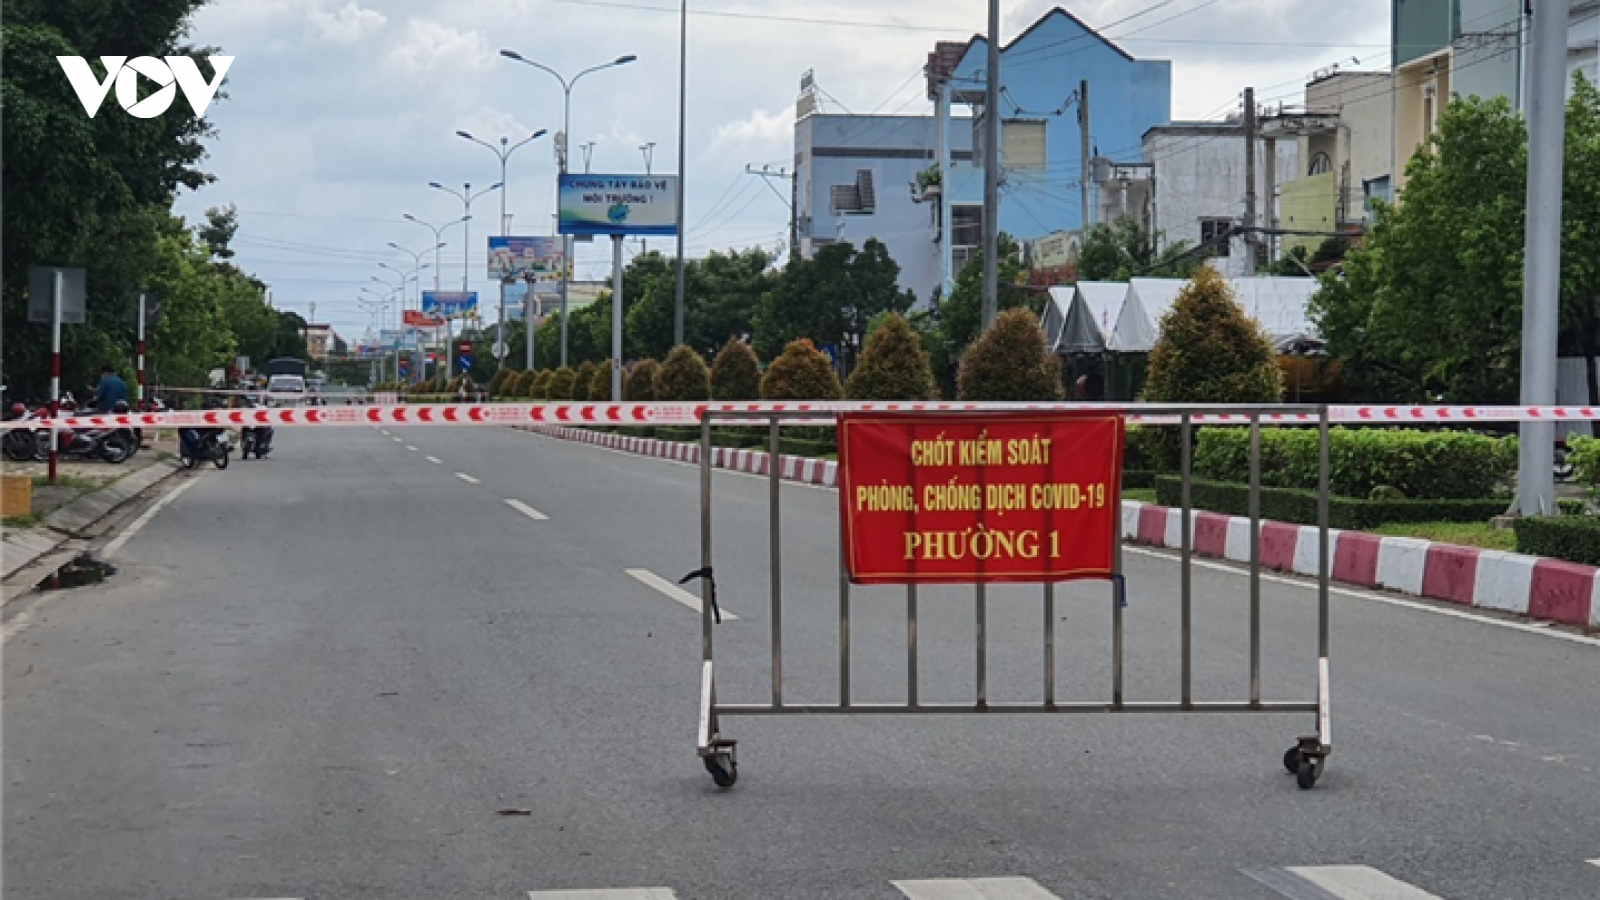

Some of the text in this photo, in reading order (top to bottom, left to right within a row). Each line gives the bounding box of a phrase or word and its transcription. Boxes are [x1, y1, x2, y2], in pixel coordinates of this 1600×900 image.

[911, 428, 1051, 466] CHỐT KIỂM SOÁT
[856, 474, 1105, 517] PHÒNG, CHỐNG DỊCH COVID-19
[903, 523, 1062, 560] PHƯỜNG 1
